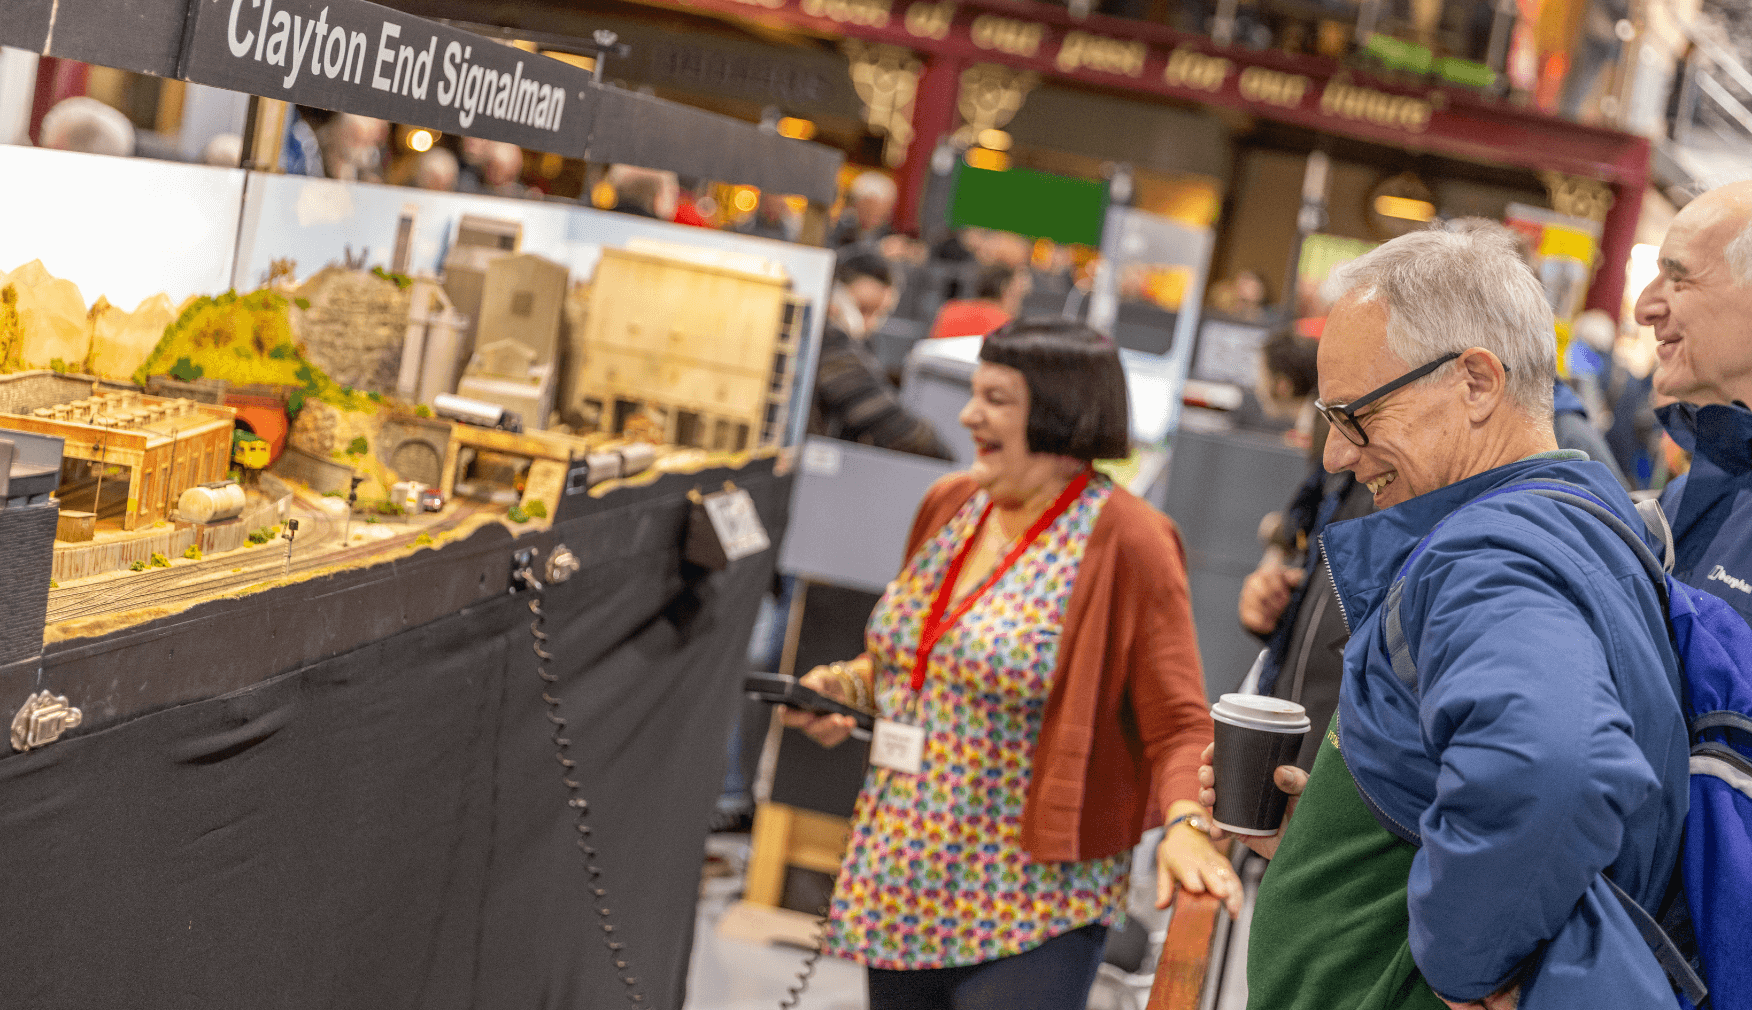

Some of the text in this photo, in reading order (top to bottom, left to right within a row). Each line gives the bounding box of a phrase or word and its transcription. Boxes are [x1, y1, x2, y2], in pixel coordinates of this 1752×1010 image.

[228, 0, 367, 89] Clayton
[372, 21, 438, 100] End
[437, 41, 566, 132] Signalman
[970, 15, 1044, 58] our
[1163, 42, 1231, 92] for
[1239, 66, 1310, 110] our
